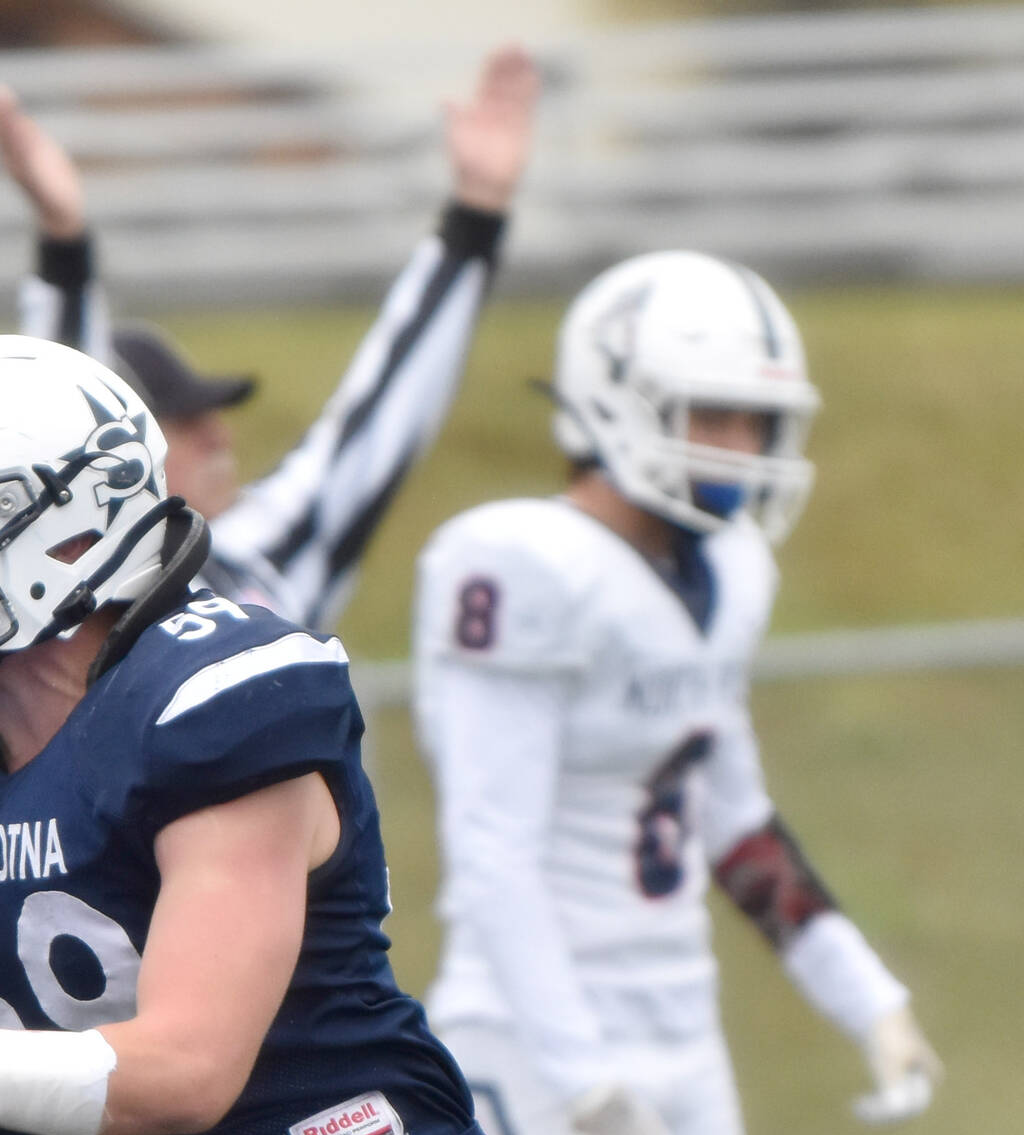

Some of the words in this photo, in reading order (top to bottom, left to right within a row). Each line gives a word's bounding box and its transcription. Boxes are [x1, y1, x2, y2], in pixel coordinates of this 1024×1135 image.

[84, 414, 153, 508] S
[158, 597, 250, 640] 59
[454, 573, 502, 653] 8
